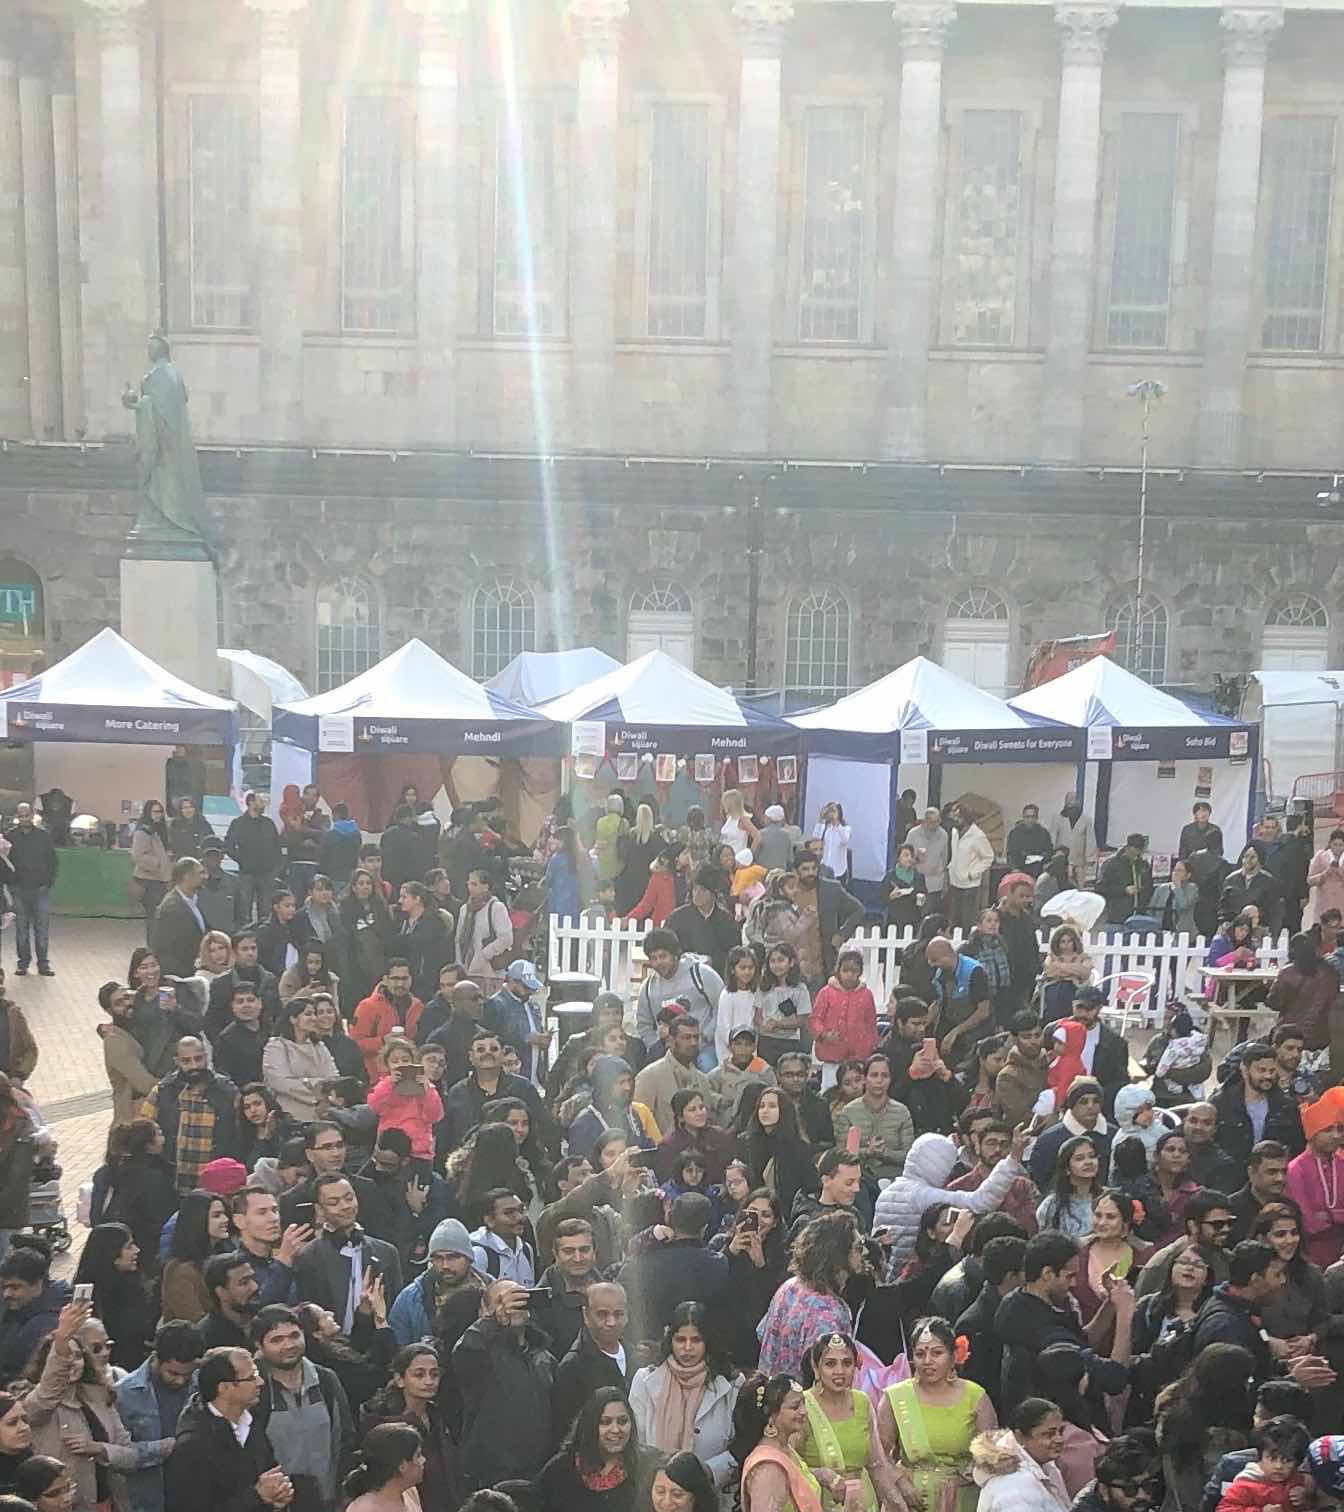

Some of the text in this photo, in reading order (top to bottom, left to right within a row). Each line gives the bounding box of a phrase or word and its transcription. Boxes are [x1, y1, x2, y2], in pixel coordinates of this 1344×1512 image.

[105, 719, 180, 733] More Catering
[370, 725, 398, 735] Diwali
[381, 735, 409, 745] square
[464, 731, 501, 743] Mehndi
[711, 737, 747, 748] Mehndi
[974, 739, 998, 751] Diwali
[1026, 738, 1038, 749] for
[1038, 738, 1073, 751] Everyone
